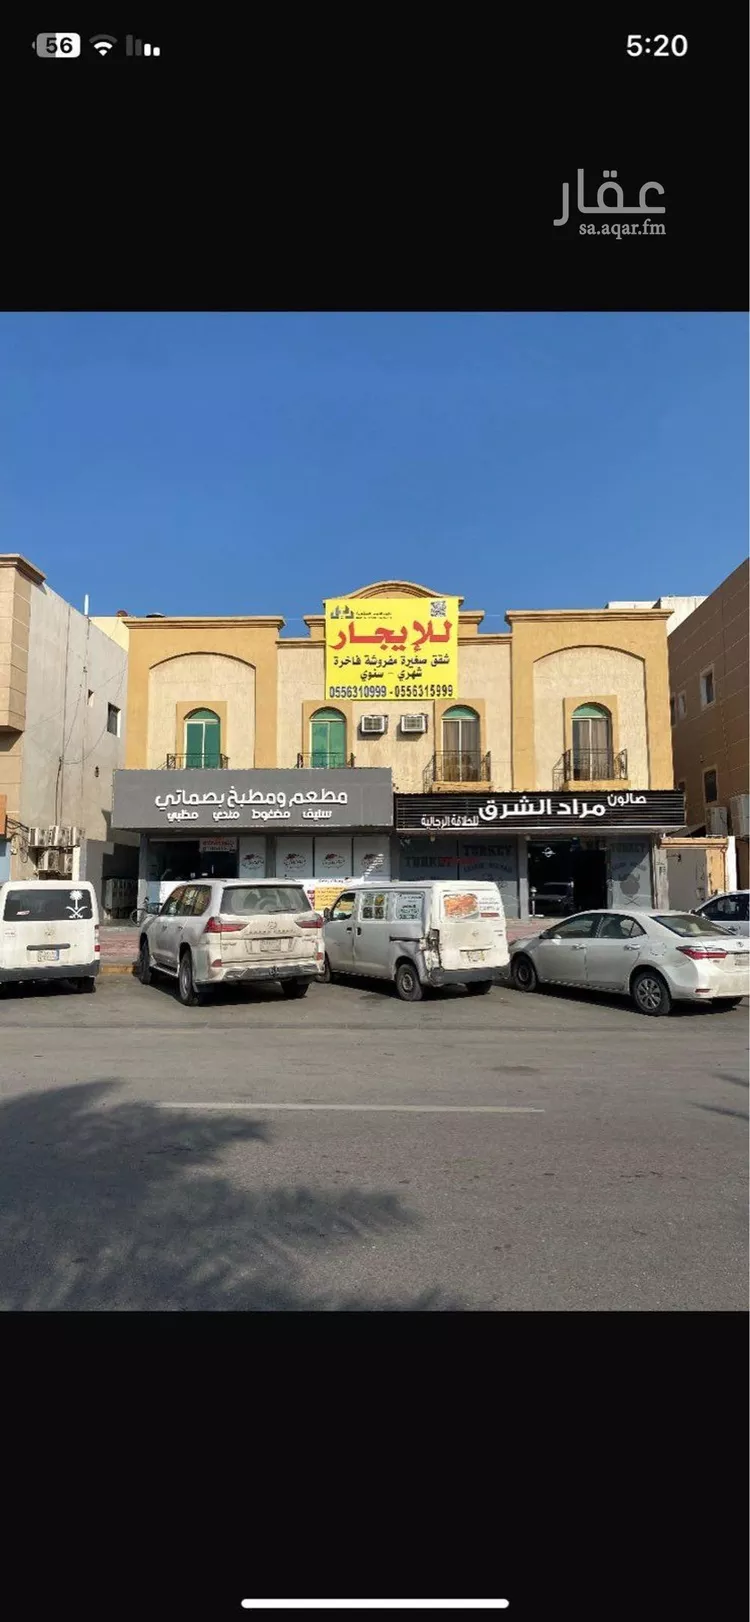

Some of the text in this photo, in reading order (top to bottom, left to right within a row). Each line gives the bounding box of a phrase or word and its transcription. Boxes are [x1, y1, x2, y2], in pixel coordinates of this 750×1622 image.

[328, 619, 453, 653] للإيجار
[333, 653, 450, 669] شقق صغيرة مفروشة فاخرة
[360, 668, 384, 682] سنوي
[397, 667, 423, 682] شهري
[329, 685, 387, 698] 0556310999
[394, 684, 453, 698] 0556315999
[155, 785, 348, 811] مطعم ومطبخ بصماتي
[607, 793, 647, 807] صالون
[167, 808, 333, 822] سليق مضغوط مندي مظبي
[478, 796, 606, 821] مراد الشرق
[421, 814, 450, 830] الرجالية
